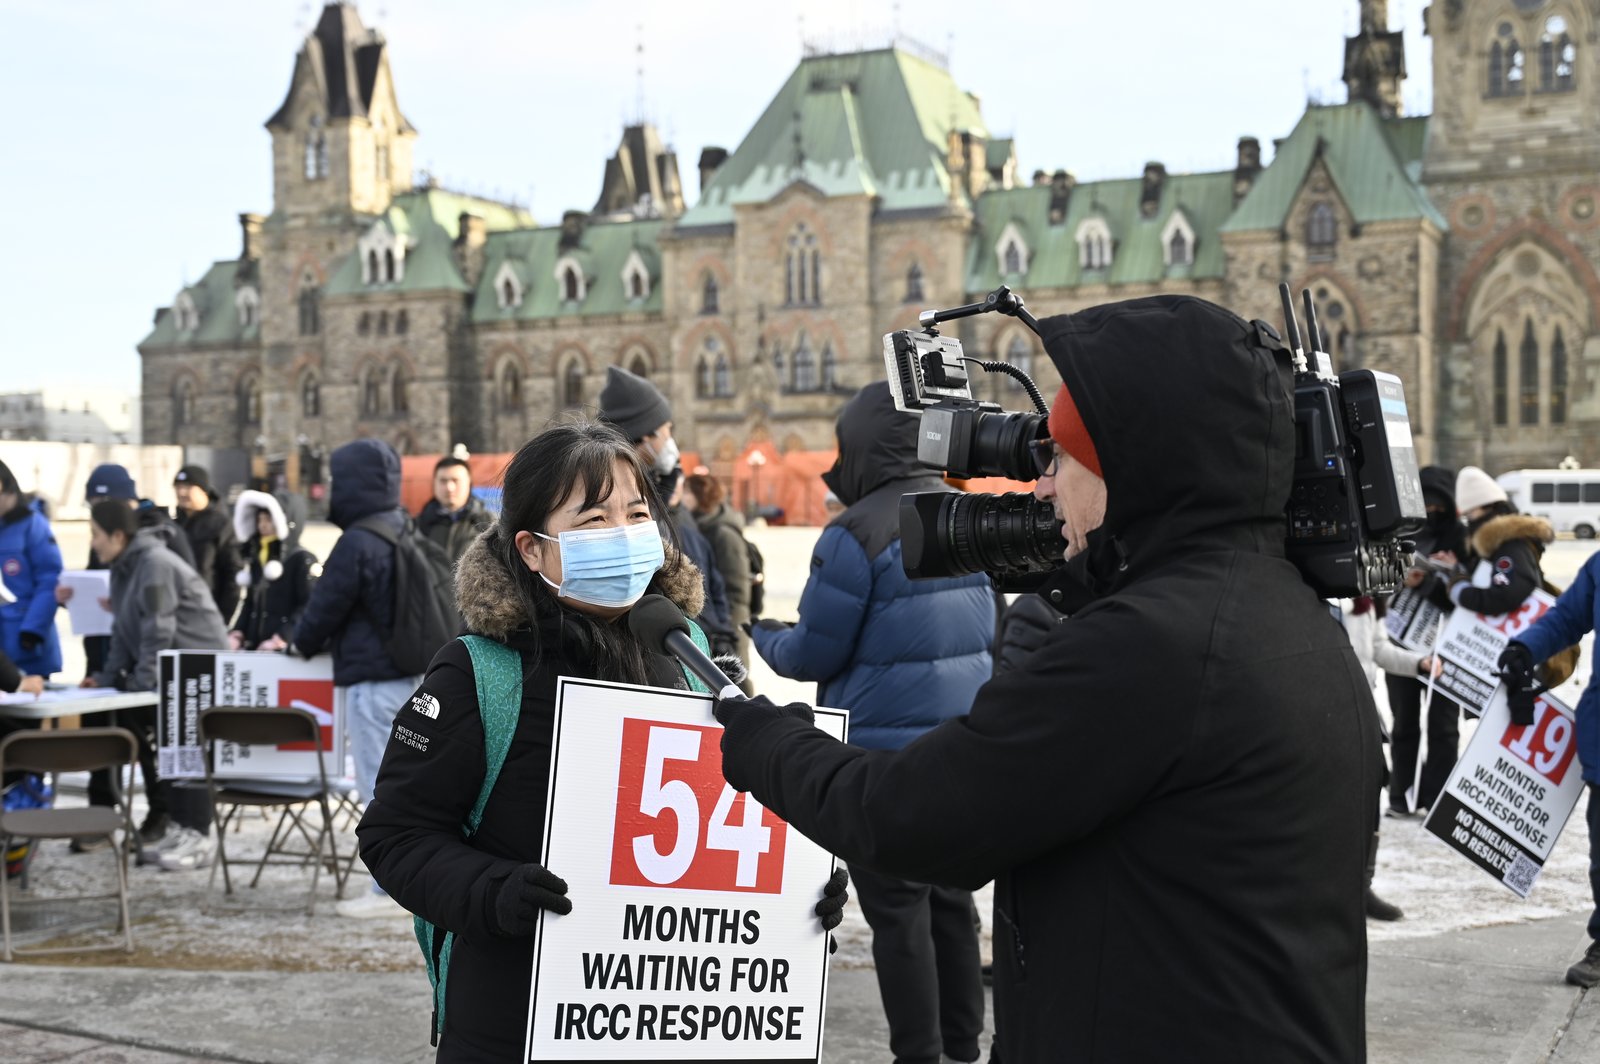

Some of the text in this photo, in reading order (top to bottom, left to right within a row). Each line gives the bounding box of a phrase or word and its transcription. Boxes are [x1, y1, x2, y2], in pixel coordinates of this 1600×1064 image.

[412, 697, 430, 708] NORTH
[412, 703, 428, 715] FACE
[422, 693, 433, 702] THE
[394, 732, 427, 752] EXPLORING
[397, 725, 429, 744] NEVER STOP
[1509, 701, 1572, 774] 19
[1475, 765, 1549, 825] WAITING FOR
[1494, 757, 1546, 801] MONTHS
[632, 726, 771, 887] 54
[1455, 809, 1473, 827] NO
[1457, 777, 1548, 849] IRCC RESPONSE
[1452, 827, 1470, 843] NO
[622, 904, 760, 945] MONTHS
[582, 952, 789, 993] WAITING FOR
[554, 1002, 804, 1041] IRCC RESPONSE
